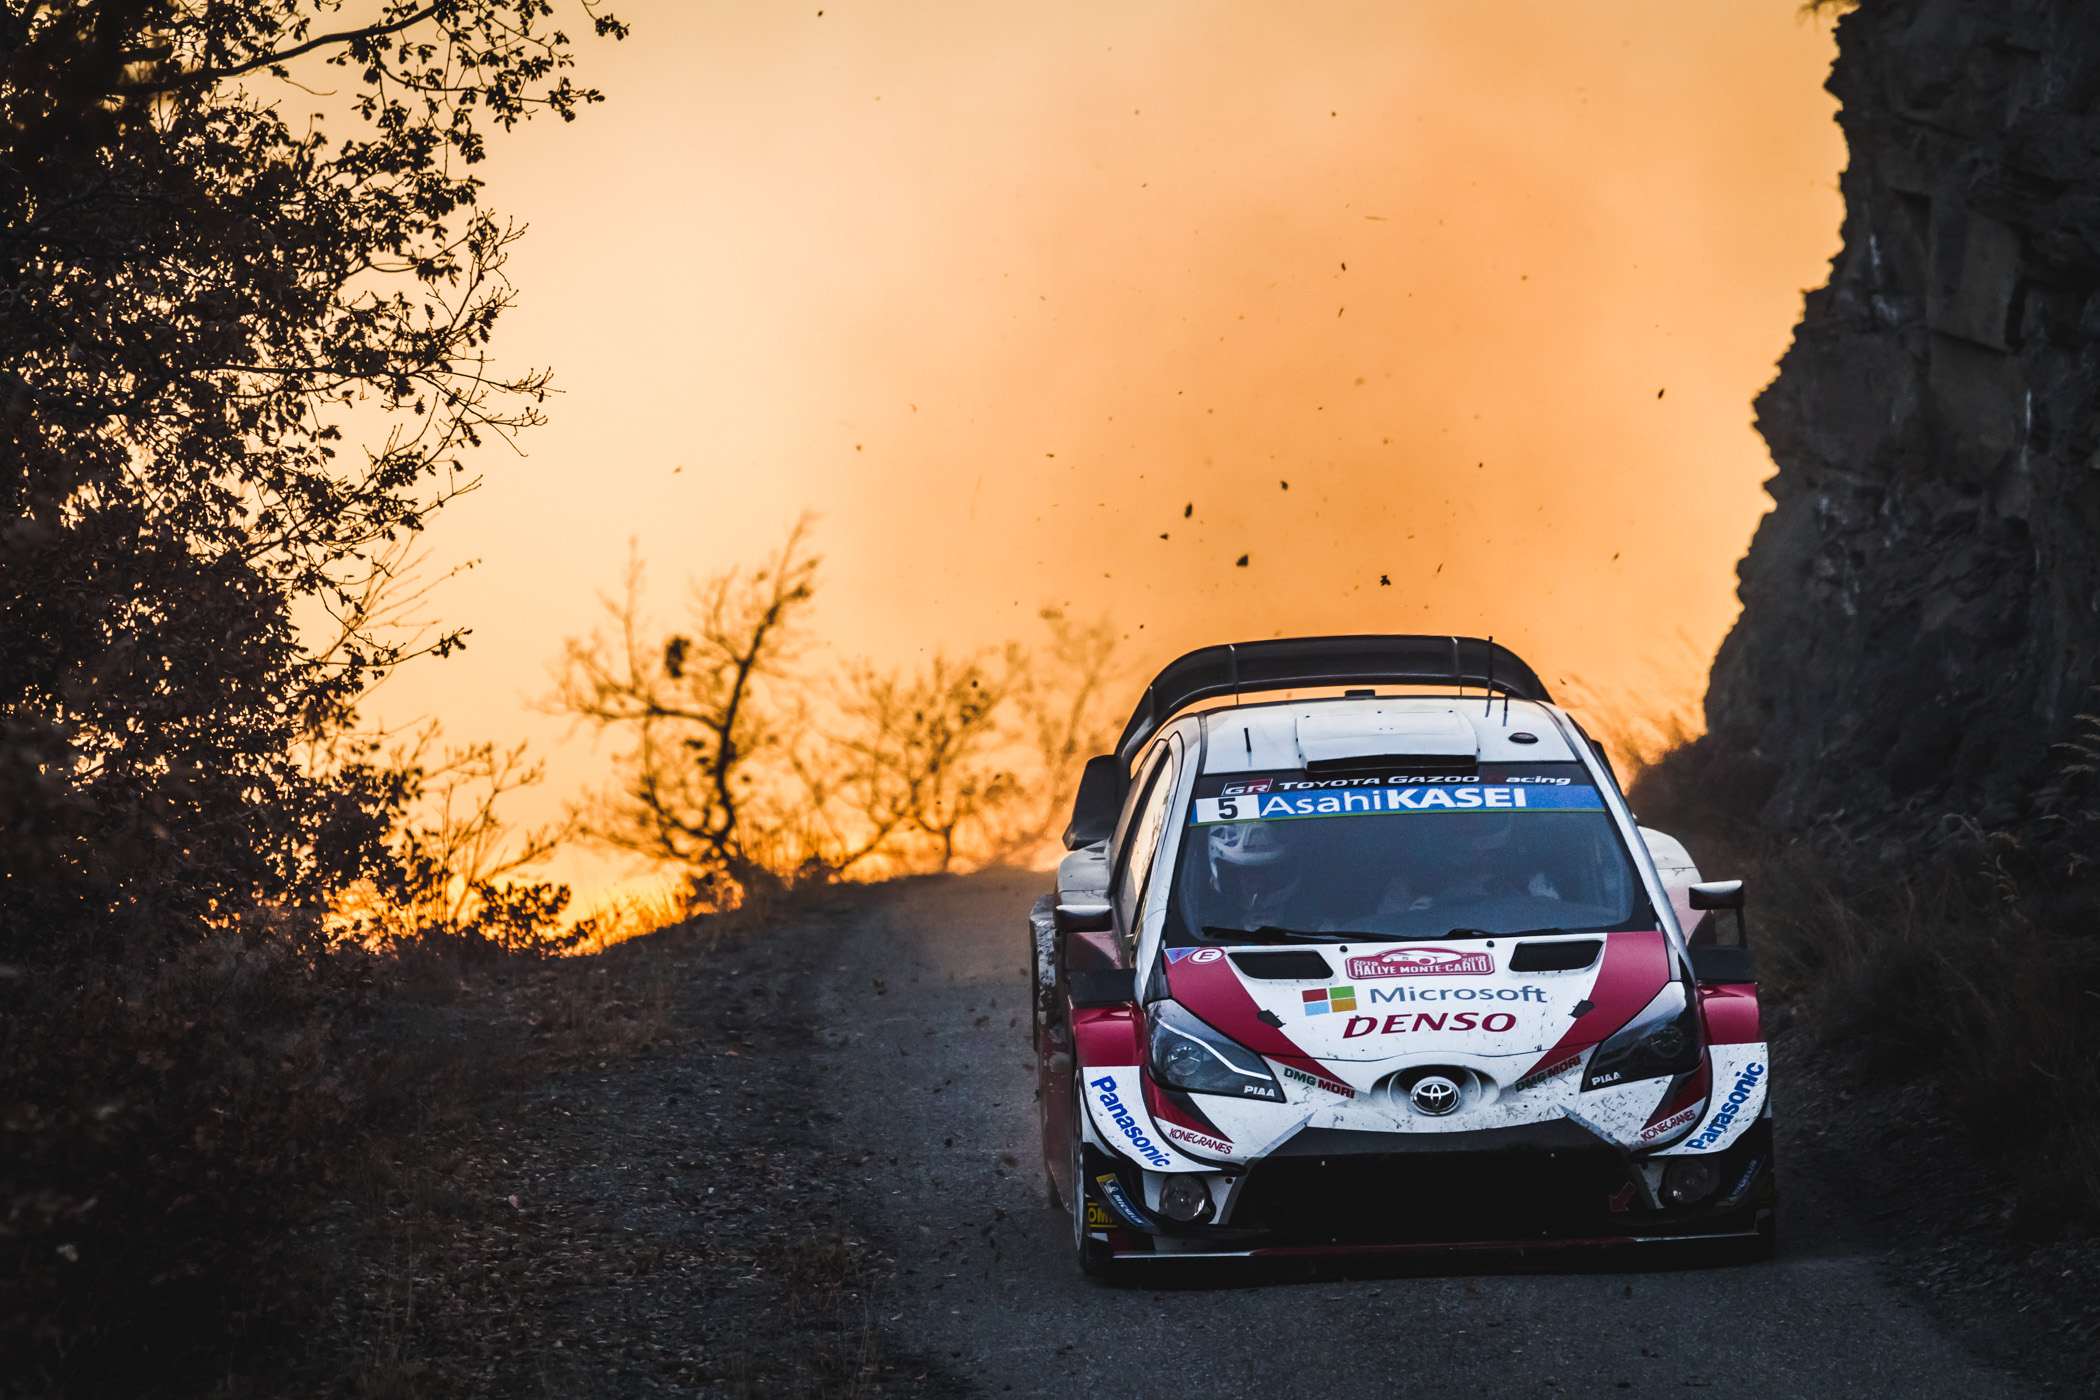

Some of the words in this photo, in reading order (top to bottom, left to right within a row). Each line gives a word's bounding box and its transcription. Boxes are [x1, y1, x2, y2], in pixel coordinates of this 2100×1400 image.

[1225, 784, 1268, 795] GR
[1279, 778, 1380, 790] TOYOTA
[1388, 775, 1480, 784] GAZOO
[1218, 797, 1238, 820] 5
[1261, 788, 1527, 817] AsahiKASEI
[1199, 951, 1215, 960] E
[1354, 963, 1396, 976] RALLYE
[1370, 985, 1548, 1004] Microsoft
[1343, 1012, 1517, 1039] DENSO
[1284, 1067, 1317, 1086] DMG
[1318, 1079, 1356, 1099] MORI
[1515, 1072, 1547, 1092] DMG
[1547, 1055, 1581, 1078] MORI
[1591, 1071, 1622, 1086] PIAA
[1244, 1085, 1275, 1097] PIAA
[1685, 1062, 1765, 1149] Panasonic
[1090, 1075, 1170, 1167] Panasonic
[1640, 1109, 1696, 1142] KONECRANES
[1169, 1128, 1233, 1155] KONECRANES
[1088, 1207, 1113, 1223] OM
[1112, 1194, 1145, 1224] MICHELIN
